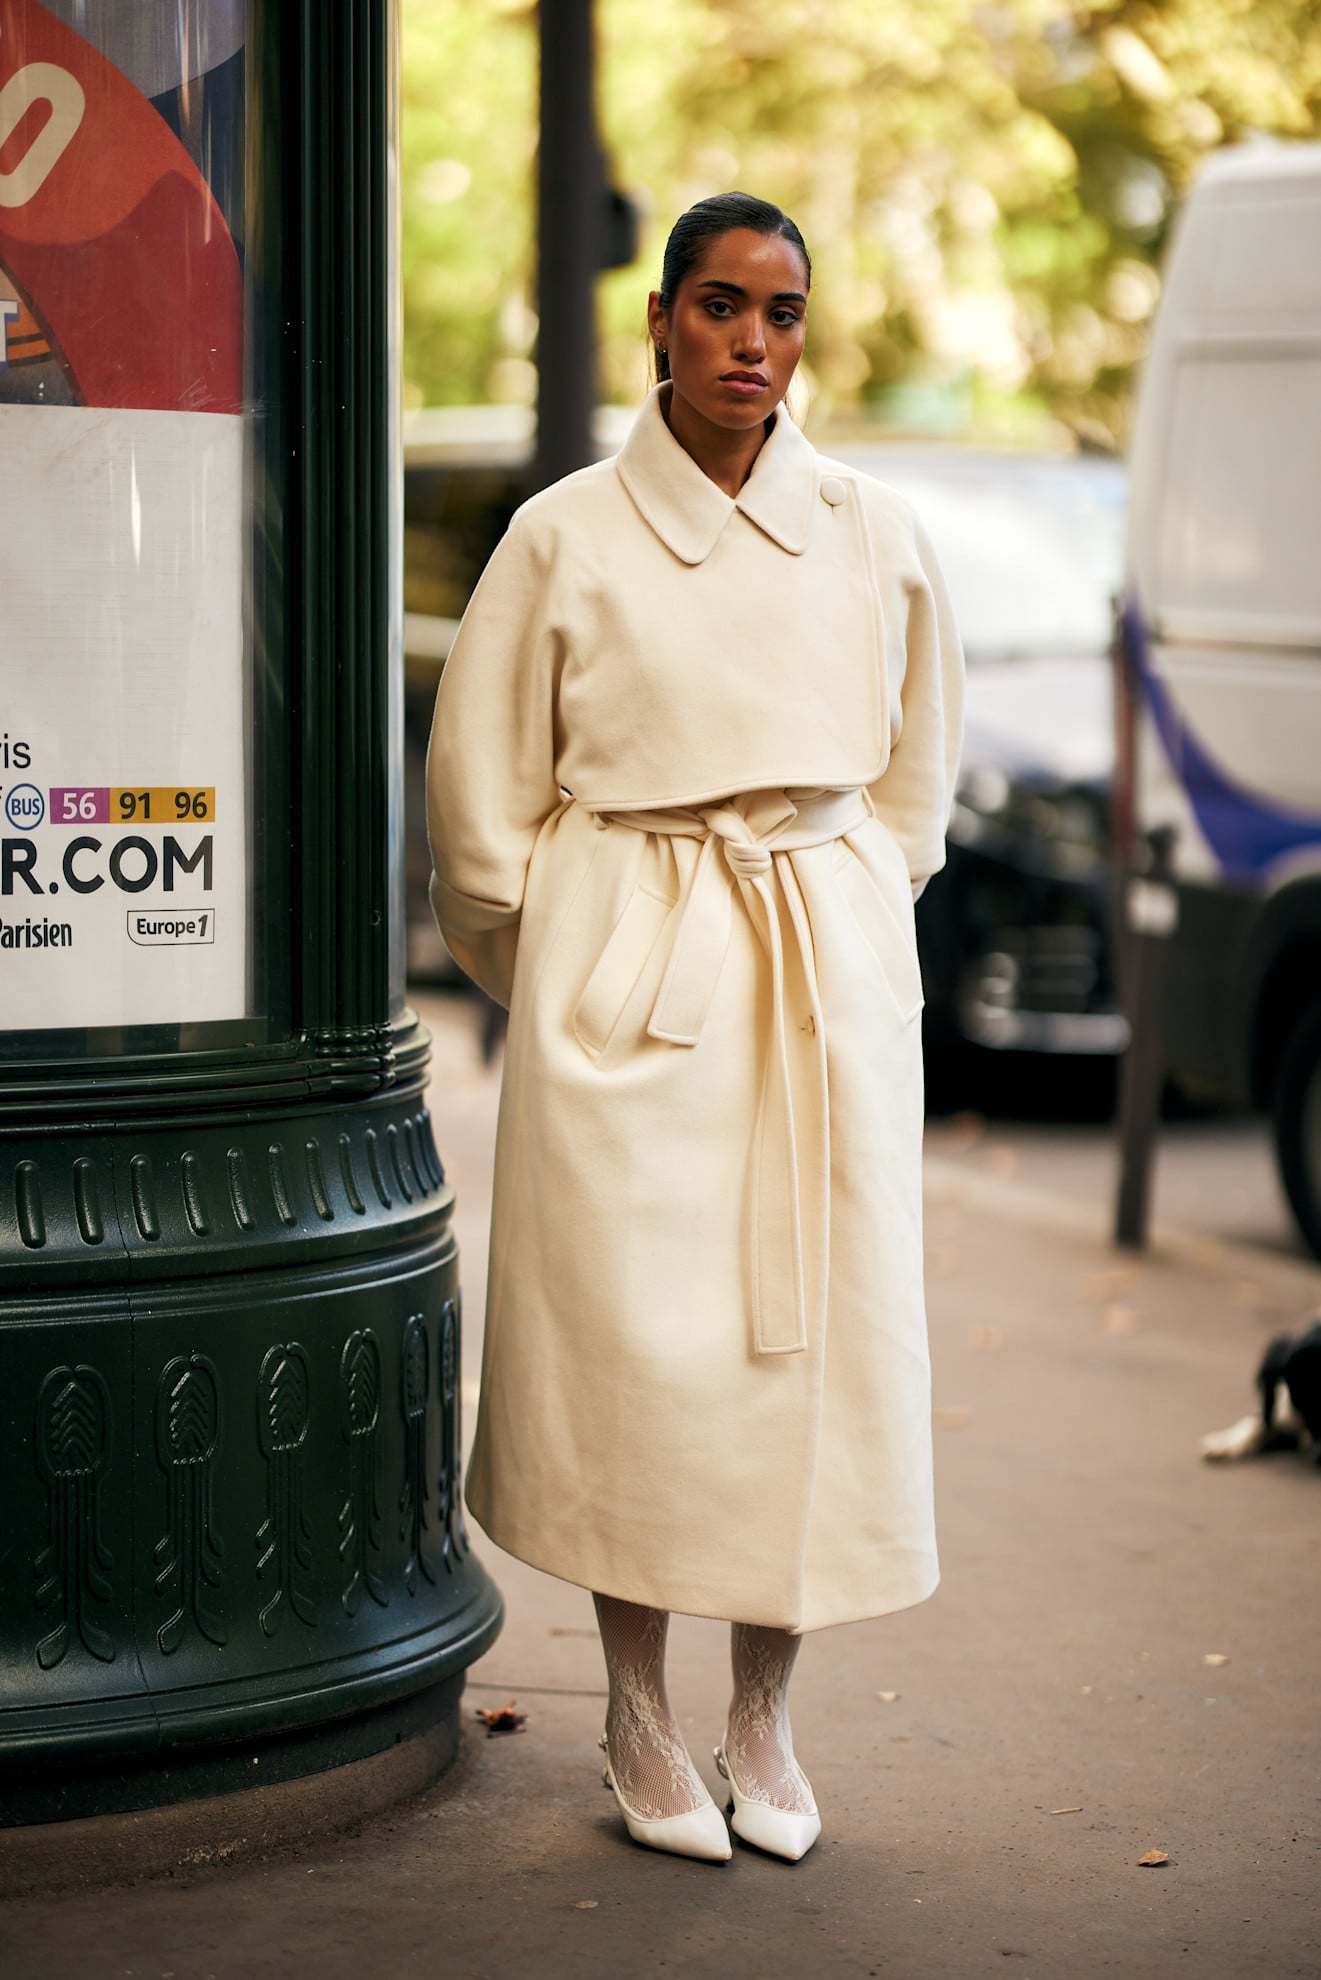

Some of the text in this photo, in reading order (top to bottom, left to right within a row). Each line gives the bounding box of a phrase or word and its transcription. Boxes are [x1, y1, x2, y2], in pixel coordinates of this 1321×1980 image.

[0, 733, 31, 769] is
[11, 791, 208, 820] BUS 56 91 96
[1, 835, 213, 896] R.COM
[0, 917, 73, 949] arisien
